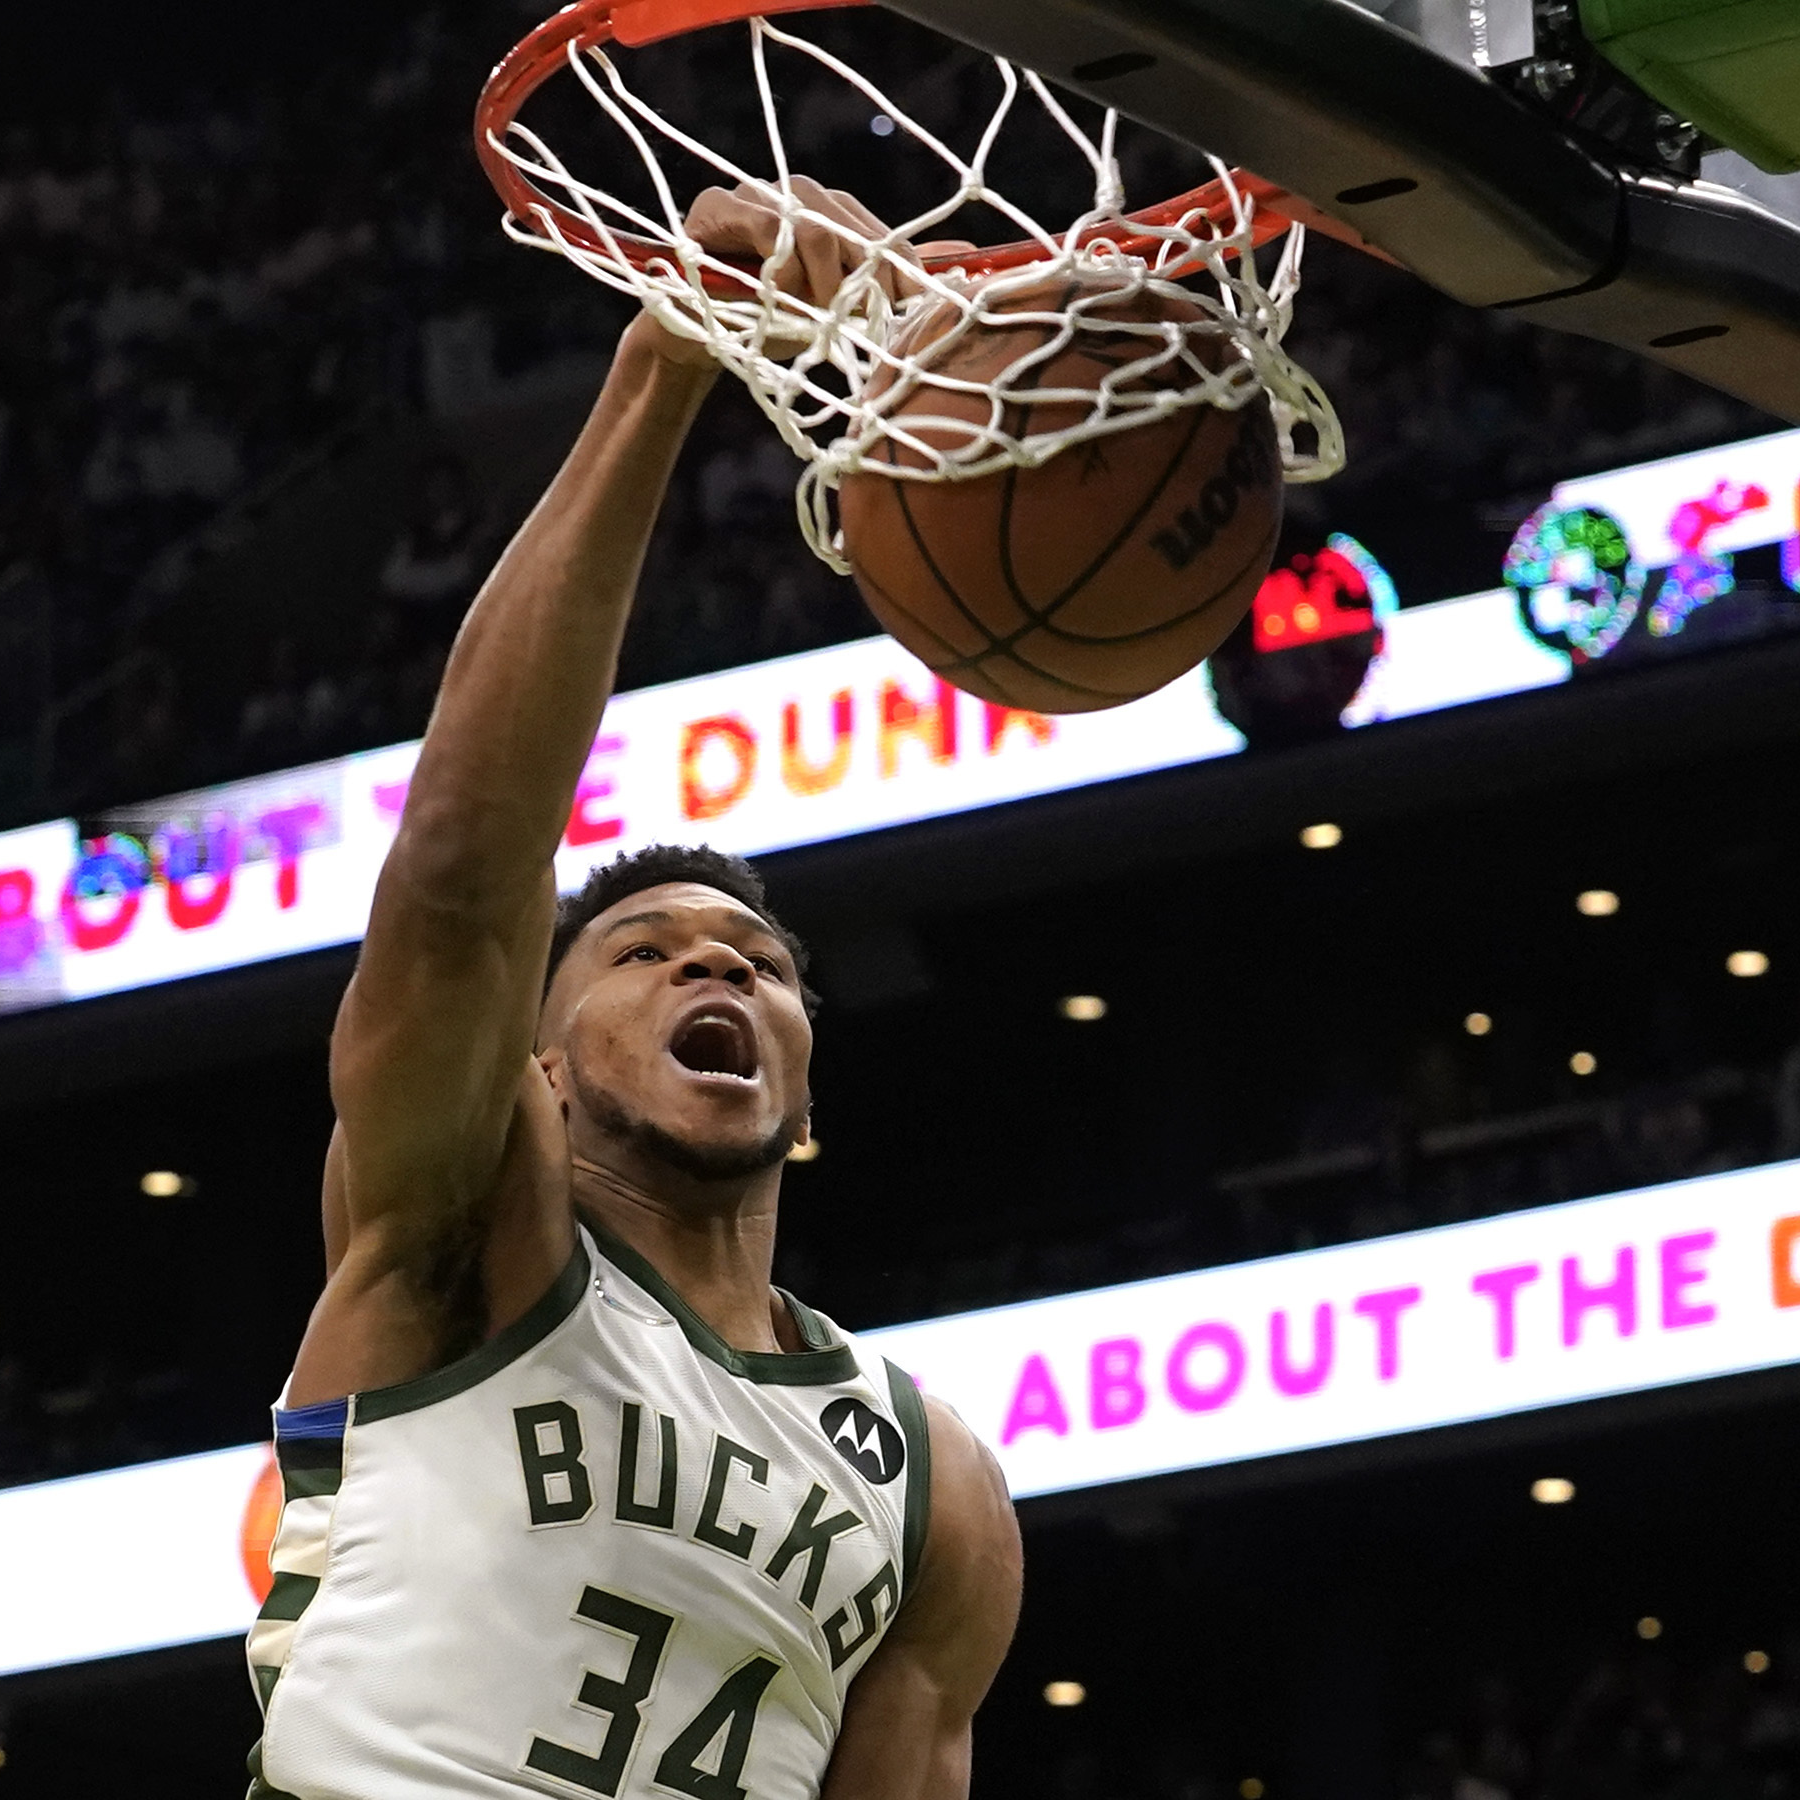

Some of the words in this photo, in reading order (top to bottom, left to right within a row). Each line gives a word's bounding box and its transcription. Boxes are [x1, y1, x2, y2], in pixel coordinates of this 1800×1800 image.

[1000, 1285, 1422, 1448] ABOUT
[1471, 1228, 1719, 1361] THE
[511, 1399, 898, 1672] BUCKS
